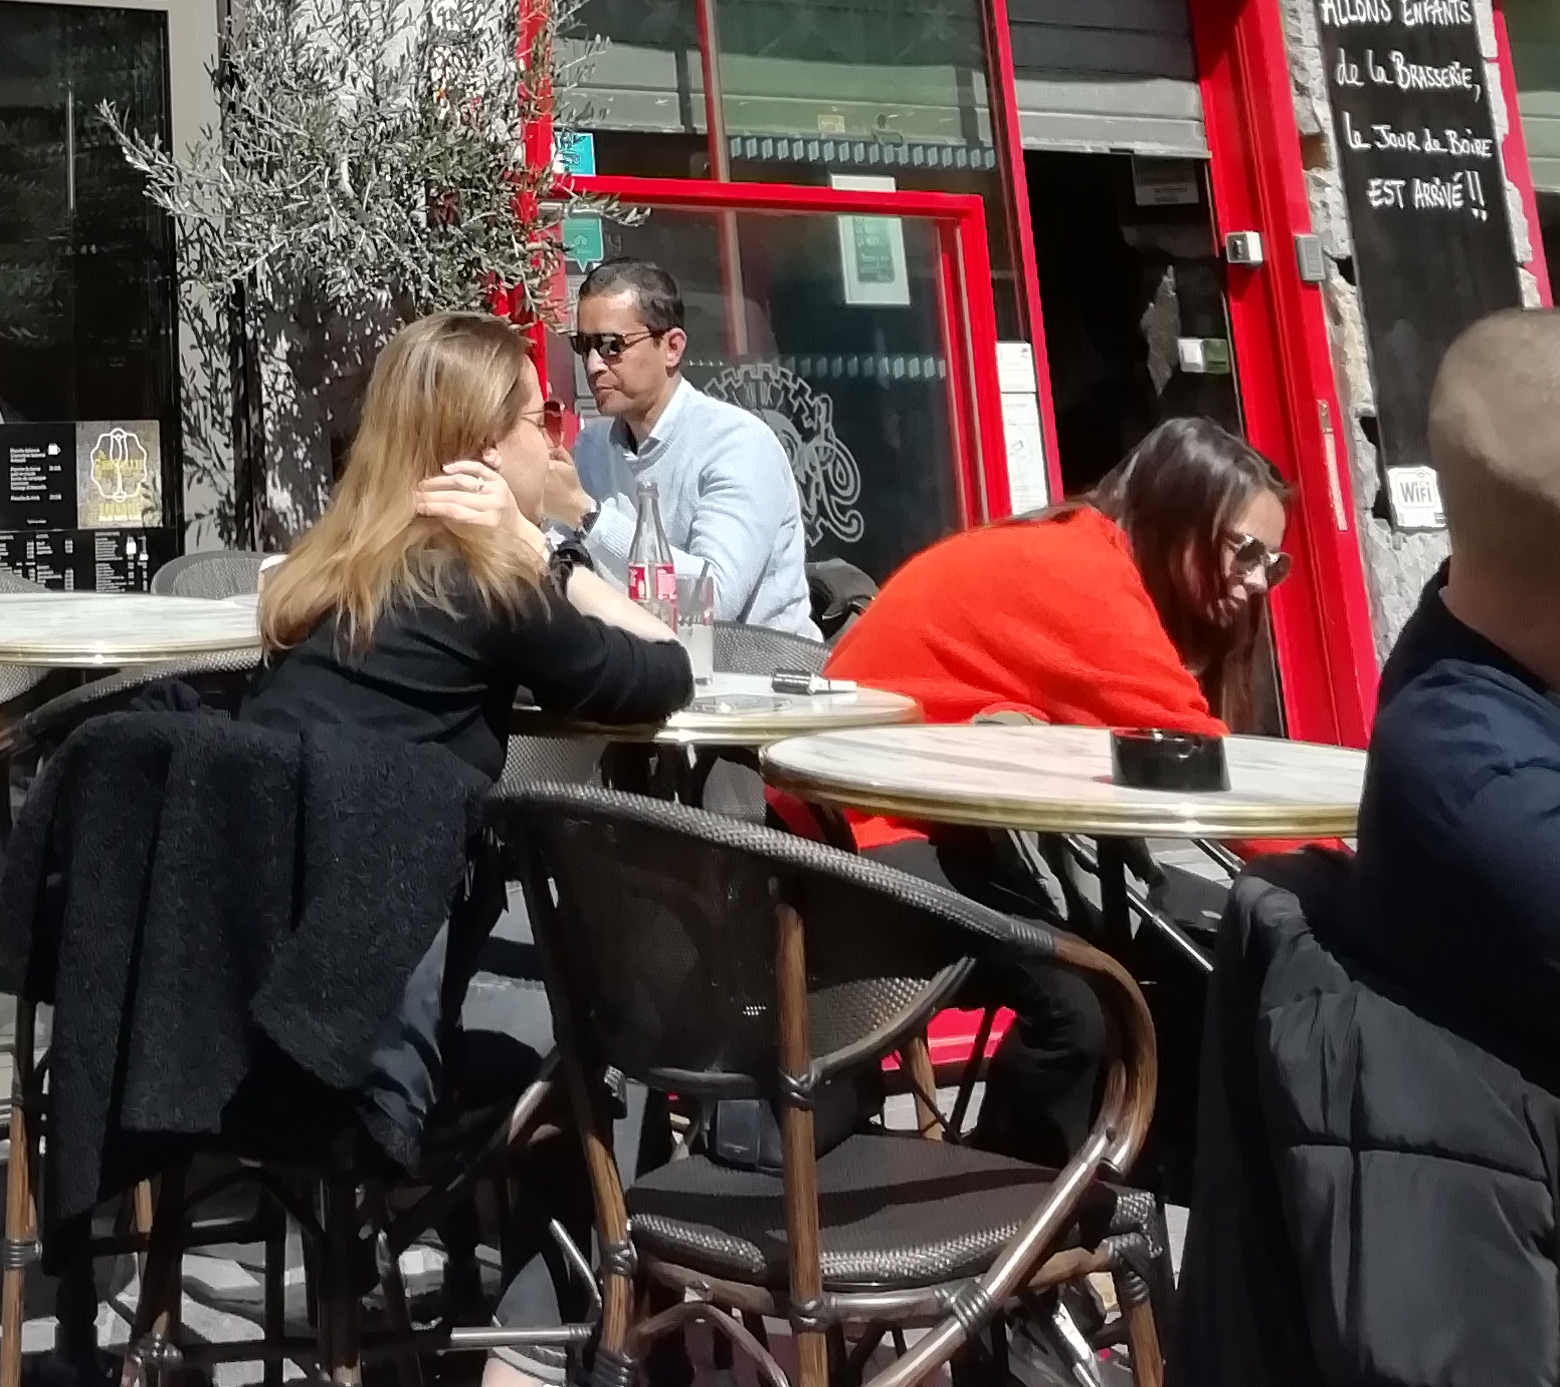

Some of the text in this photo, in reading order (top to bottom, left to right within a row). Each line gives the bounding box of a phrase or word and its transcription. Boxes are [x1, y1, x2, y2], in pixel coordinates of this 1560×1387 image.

[1336, 47, 1365, 87] de
[1422, 128, 1446, 152] de
[1366, 178, 1407, 209] EST
